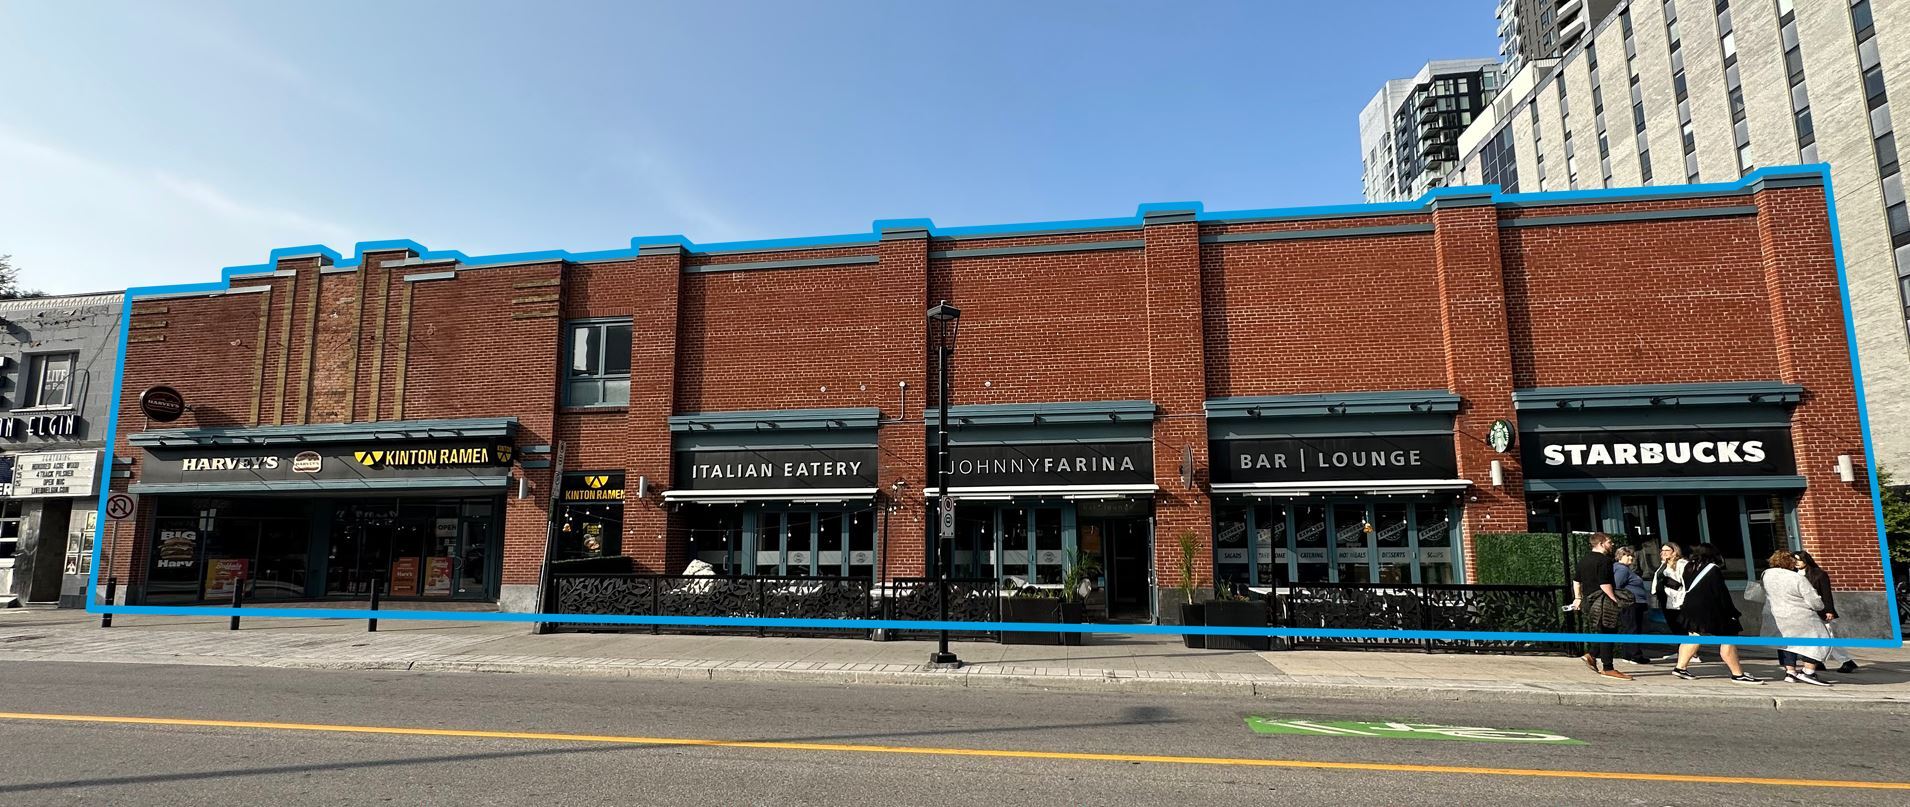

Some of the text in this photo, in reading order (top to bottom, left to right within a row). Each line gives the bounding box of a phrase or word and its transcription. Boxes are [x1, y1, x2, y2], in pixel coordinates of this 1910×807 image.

[26, 415, 74, 436] ELGIN
[385, 449, 437, 466] KINTON
[1240, 453, 1288, 469] BAR
[1318, 450, 1422, 468] LOUNGE
[1543, 440, 1766, 466] STARBUCKS
[182, 456, 279, 471] HARVEY'S
[692, 461, 862, 479] ITALIAN EATERY
[947, 455, 1135, 475] JOHNNYFARINA
[565, 489, 595, 500] KINTON
[160, 531, 197, 540] BIG
